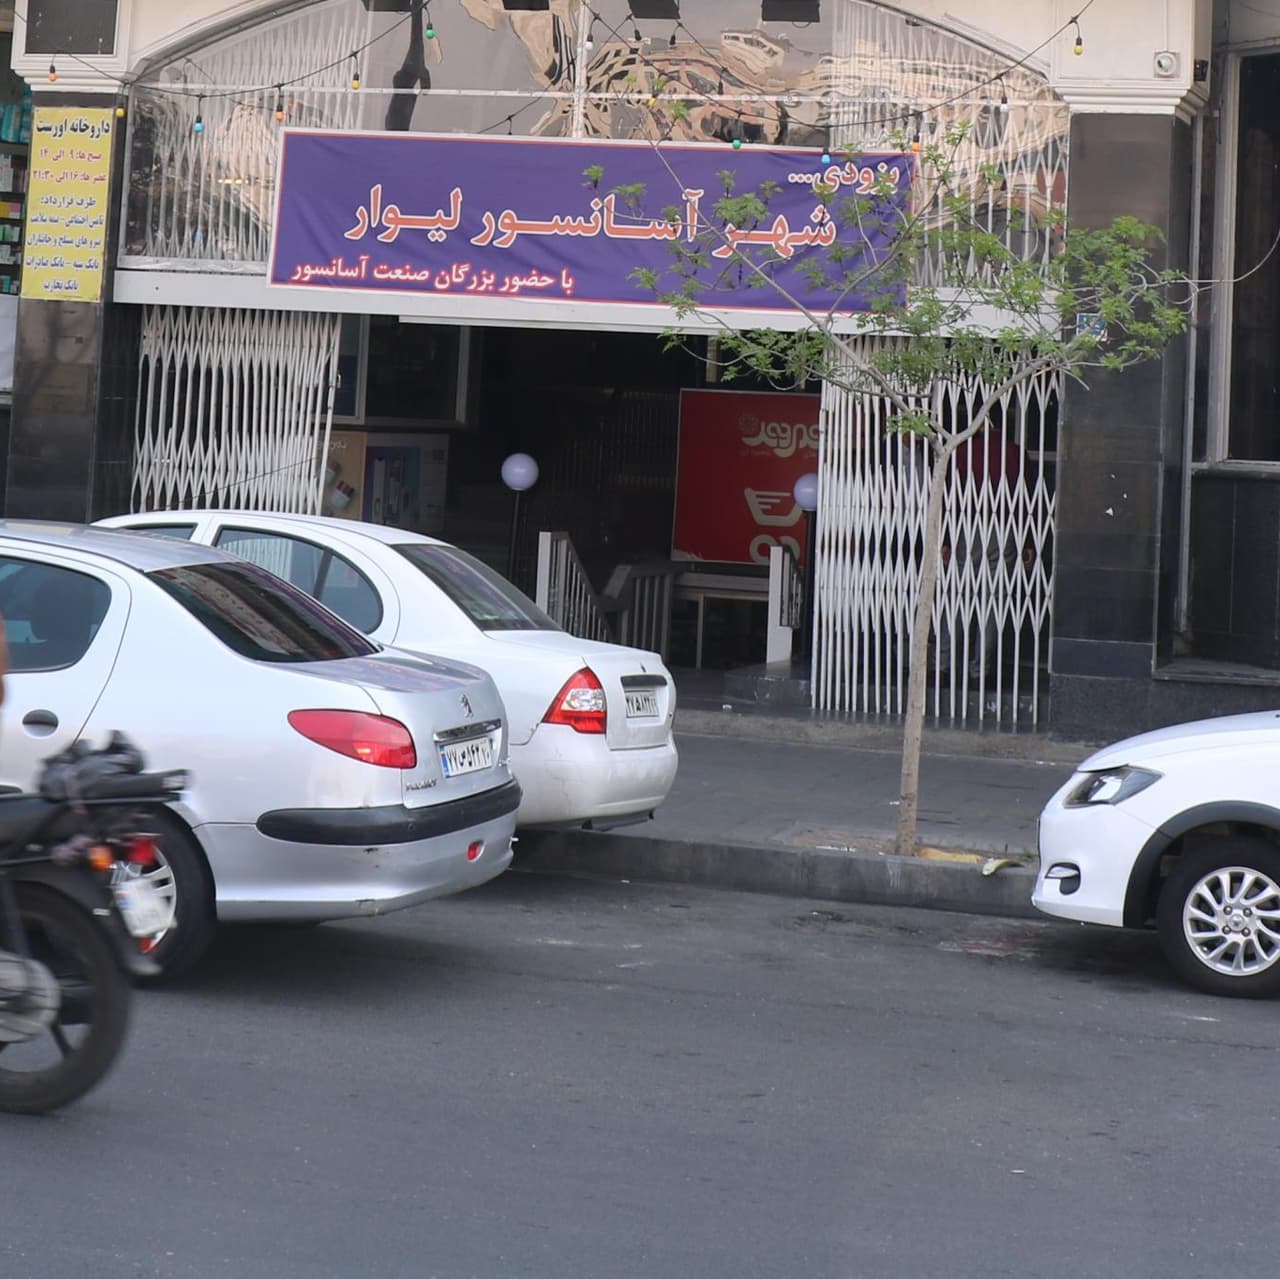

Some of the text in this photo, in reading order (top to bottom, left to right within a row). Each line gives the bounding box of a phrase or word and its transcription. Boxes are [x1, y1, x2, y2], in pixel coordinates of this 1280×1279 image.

[36, 118, 110, 139] داروخانه اورست
[343, 183, 837, 258] شهر آسانسور لیوار
[291, 254, 574, 294] با حضور بزرگان صنعت آسانسور
